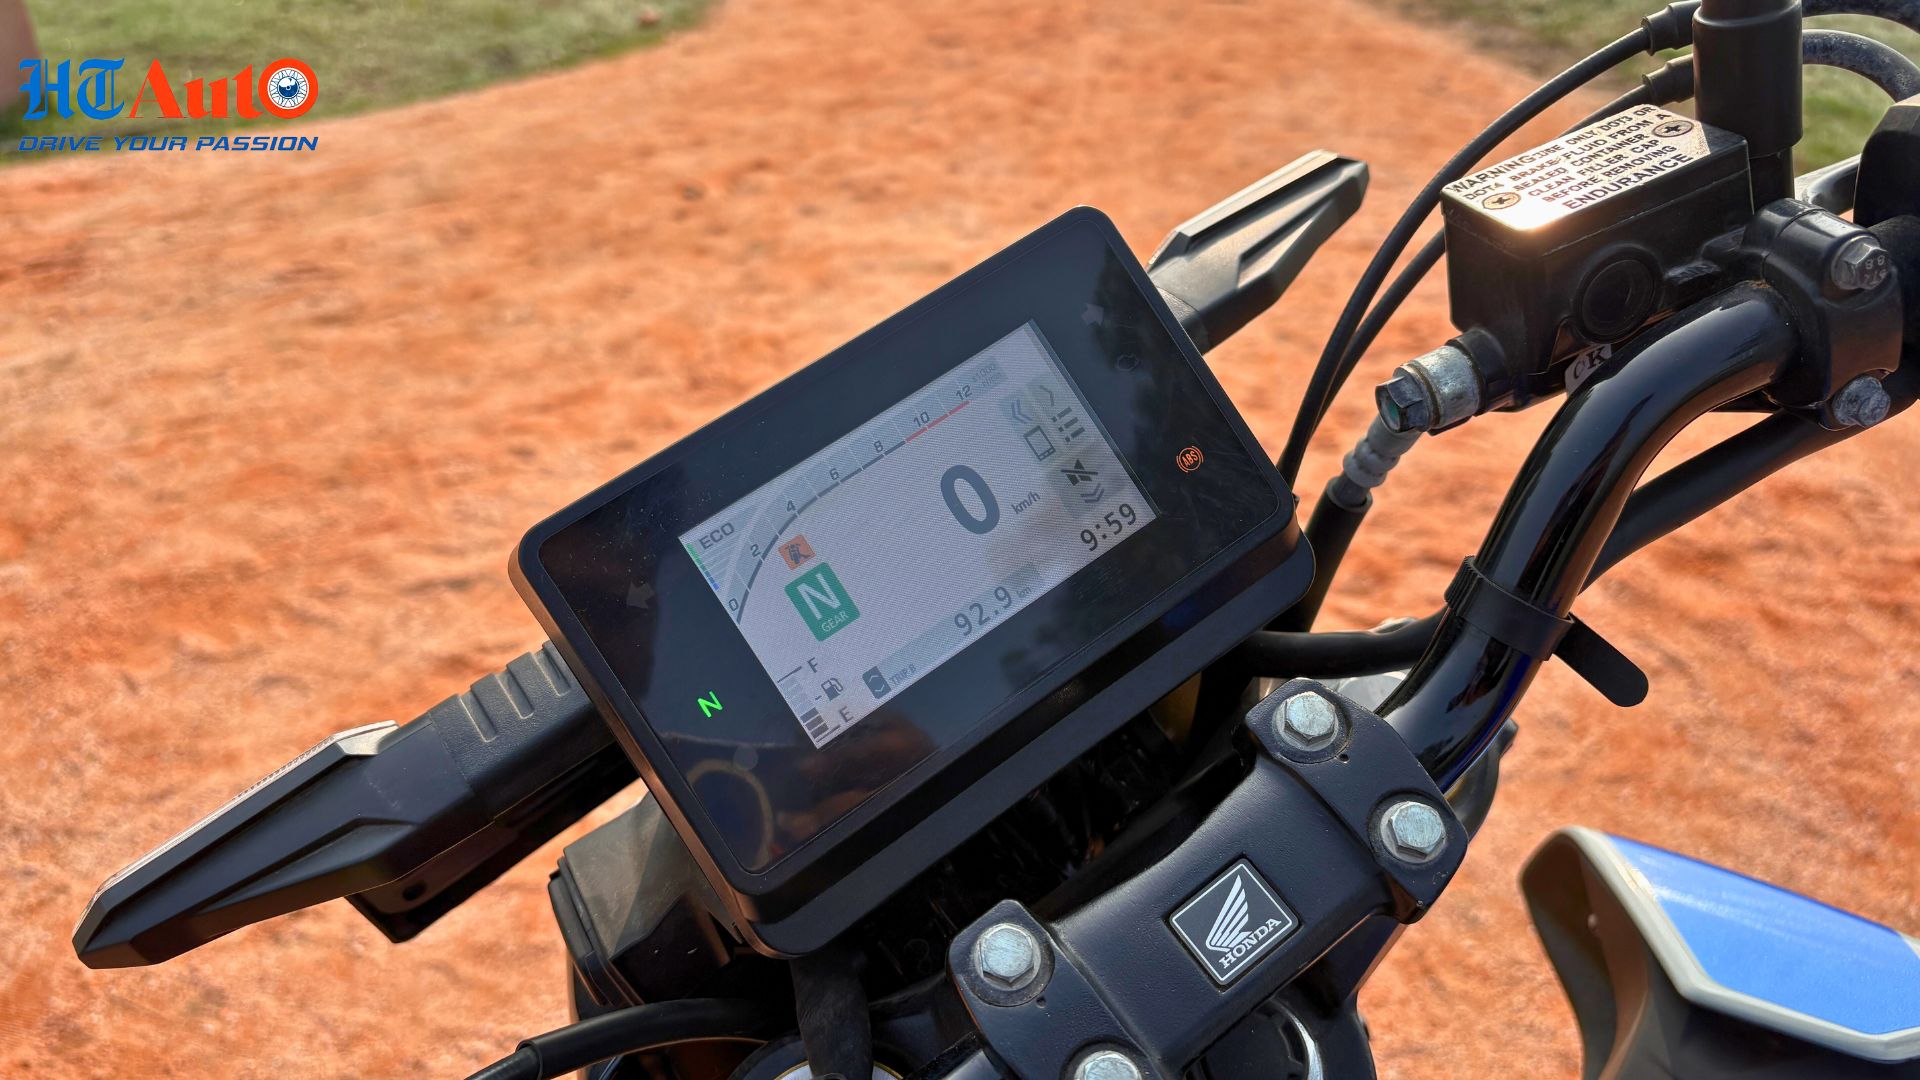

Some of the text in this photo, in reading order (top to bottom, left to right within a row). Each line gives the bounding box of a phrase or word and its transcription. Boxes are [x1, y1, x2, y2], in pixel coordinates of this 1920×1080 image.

[1562, 138, 1608, 160] FLUID
[1608, 119, 1654, 140] FROM
[1656, 113, 1671, 121] A
[1565, 129, 1598, 146] ONLY
[1599, 115, 1633, 132] DOT3
[1633, 106, 1656, 117] OR
[1513, 132, 1650, 191] SEALED CONTAINER
[1528, 139, 1660, 197] CLEAN FILLER CAP
[1542, 145, 1677, 203] BEFORE REMOVING
[1562, 153, 1694, 210] ENDURANCE
[956, 384, 972, 401] 12
[913, 411, 930, 428] 10
[873, 440, 884, 453] 8
[1181, 450, 1198, 467] ABS
[829, 468, 839, 481] 6
[786, 500, 796, 513] 4
[940, 464, 1000, 535] 0
[1011, 490, 1041, 515] km/h
[698, 522, 735, 550] ECO
[1080, 503, 1137, 551] 9:59
[750, 543, 761, 557] 2
[728, 597, 739, 612] 0
[797, 573, 841, 621] N
[821, 610, 849, 632] GEAR
[954, 585, 1032, 636] 92.9 km
[807, 657, 818, 673] F
[889, 667, 909, 686] TRIP
[698, 691, 723, 718] N
[838, 705, 854, 723] E
[1218, 918, 1282, 969] HONDA
